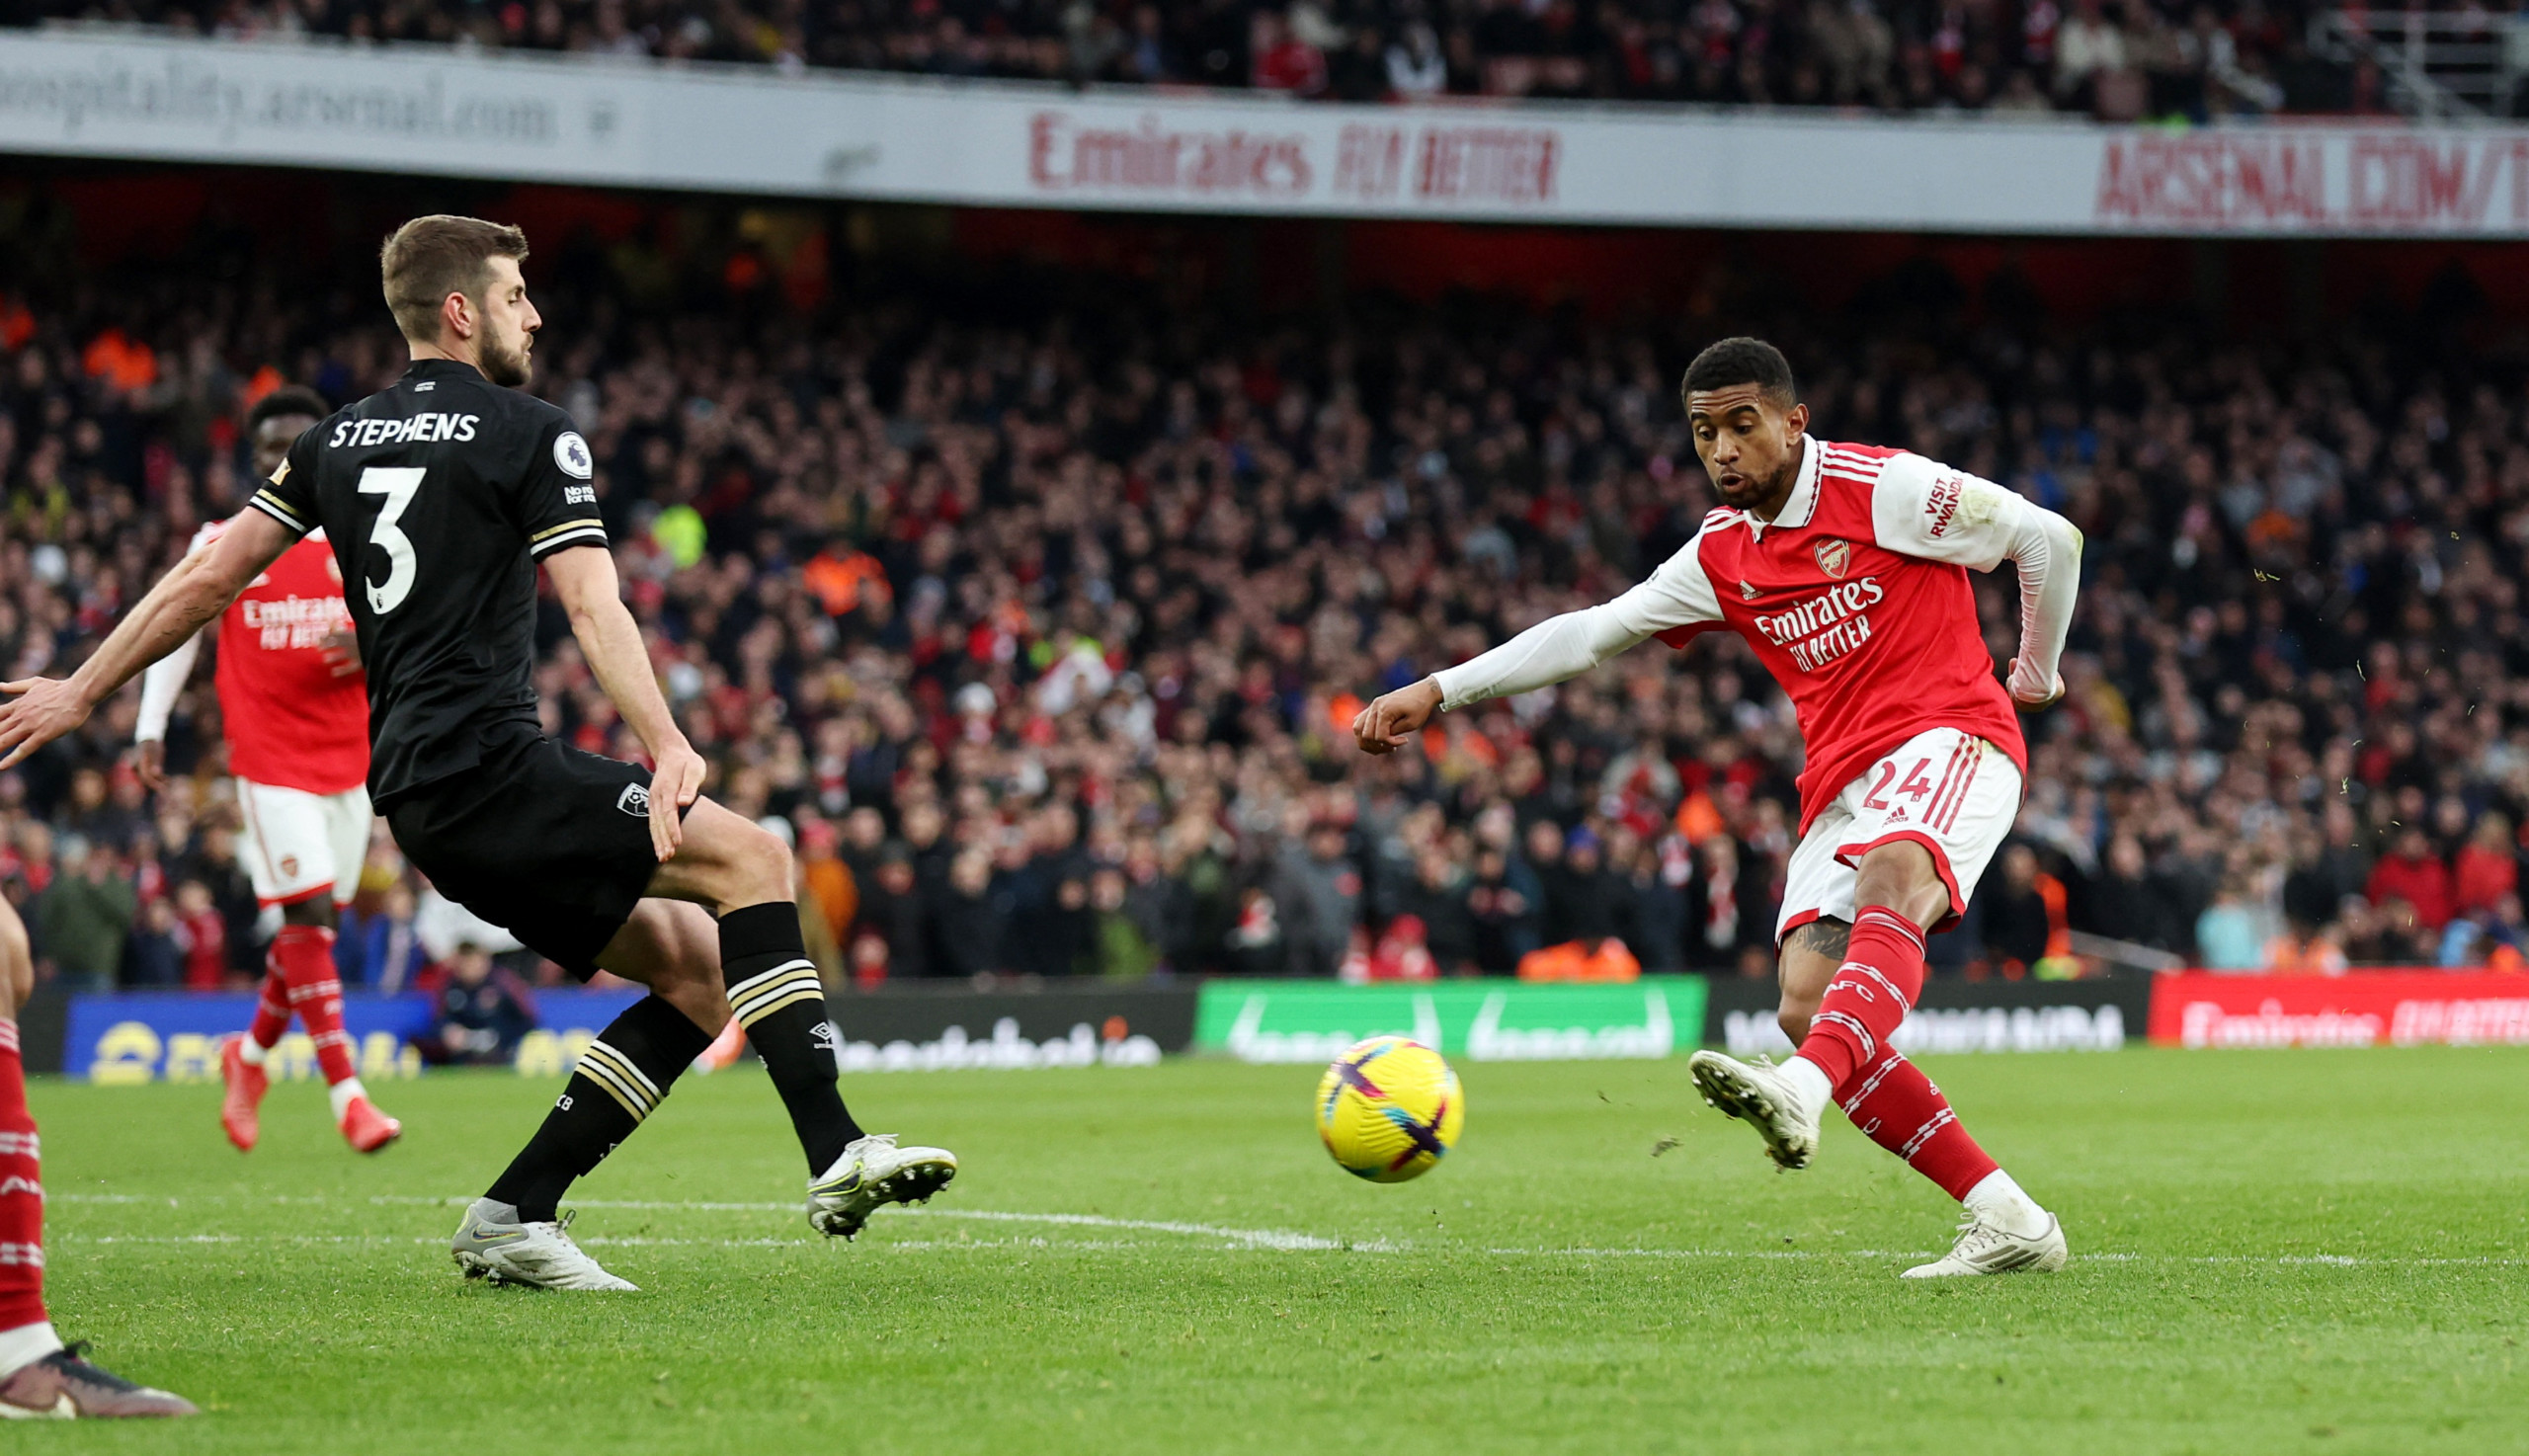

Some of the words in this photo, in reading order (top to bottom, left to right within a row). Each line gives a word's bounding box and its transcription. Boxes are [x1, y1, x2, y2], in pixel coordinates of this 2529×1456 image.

[1027, 113, 1314, 192] Emirates
[1336, 122, 1407, 196] FLY
[1413, 125, 1563, 202] BETTER
[329, 413, 480, 447] STEPHENS
[564, 485, 582, 497] No
[1924, 477, 1948, 514] VISIT
[1929, 476, 1964, 537] RWANDA
[357, 467, 428, 615] 3
[1754, 577, 1883, 646] Emirates
[1809, 613, 1872, 666] BETTER
[1863, 758, 1932, 810] 24
[1823, 980, 1875, 1004] AFC
